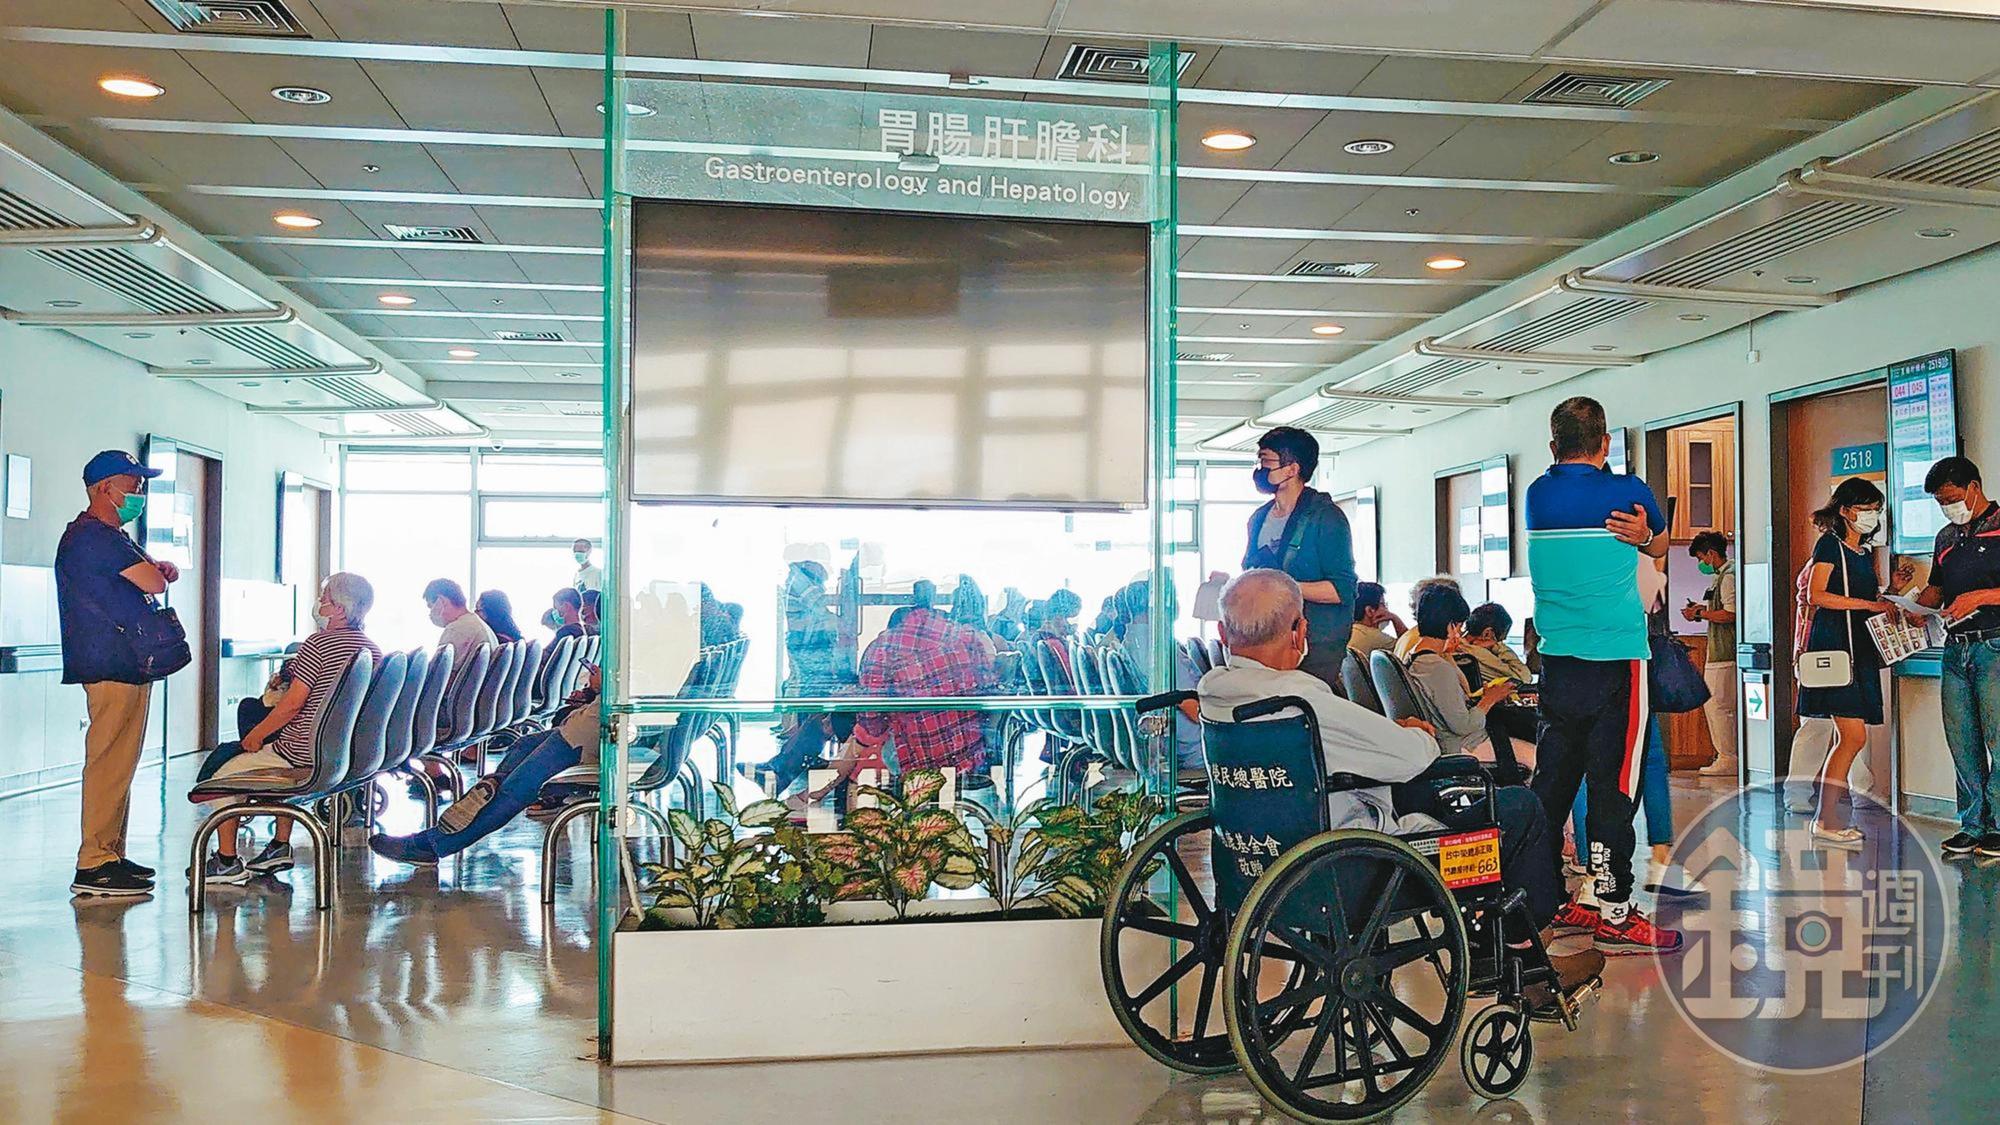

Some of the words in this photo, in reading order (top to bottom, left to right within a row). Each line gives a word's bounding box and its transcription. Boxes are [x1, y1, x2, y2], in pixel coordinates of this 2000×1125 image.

[878, 108, 1132, 165] 胃腸肝膽科
[704, 156, 930, 196] Gastroenterology
[937, 177, 982, 199] and
[990, 176, 1131, 211] Hepatology
[1842, 449, 1873, 471] 2518
